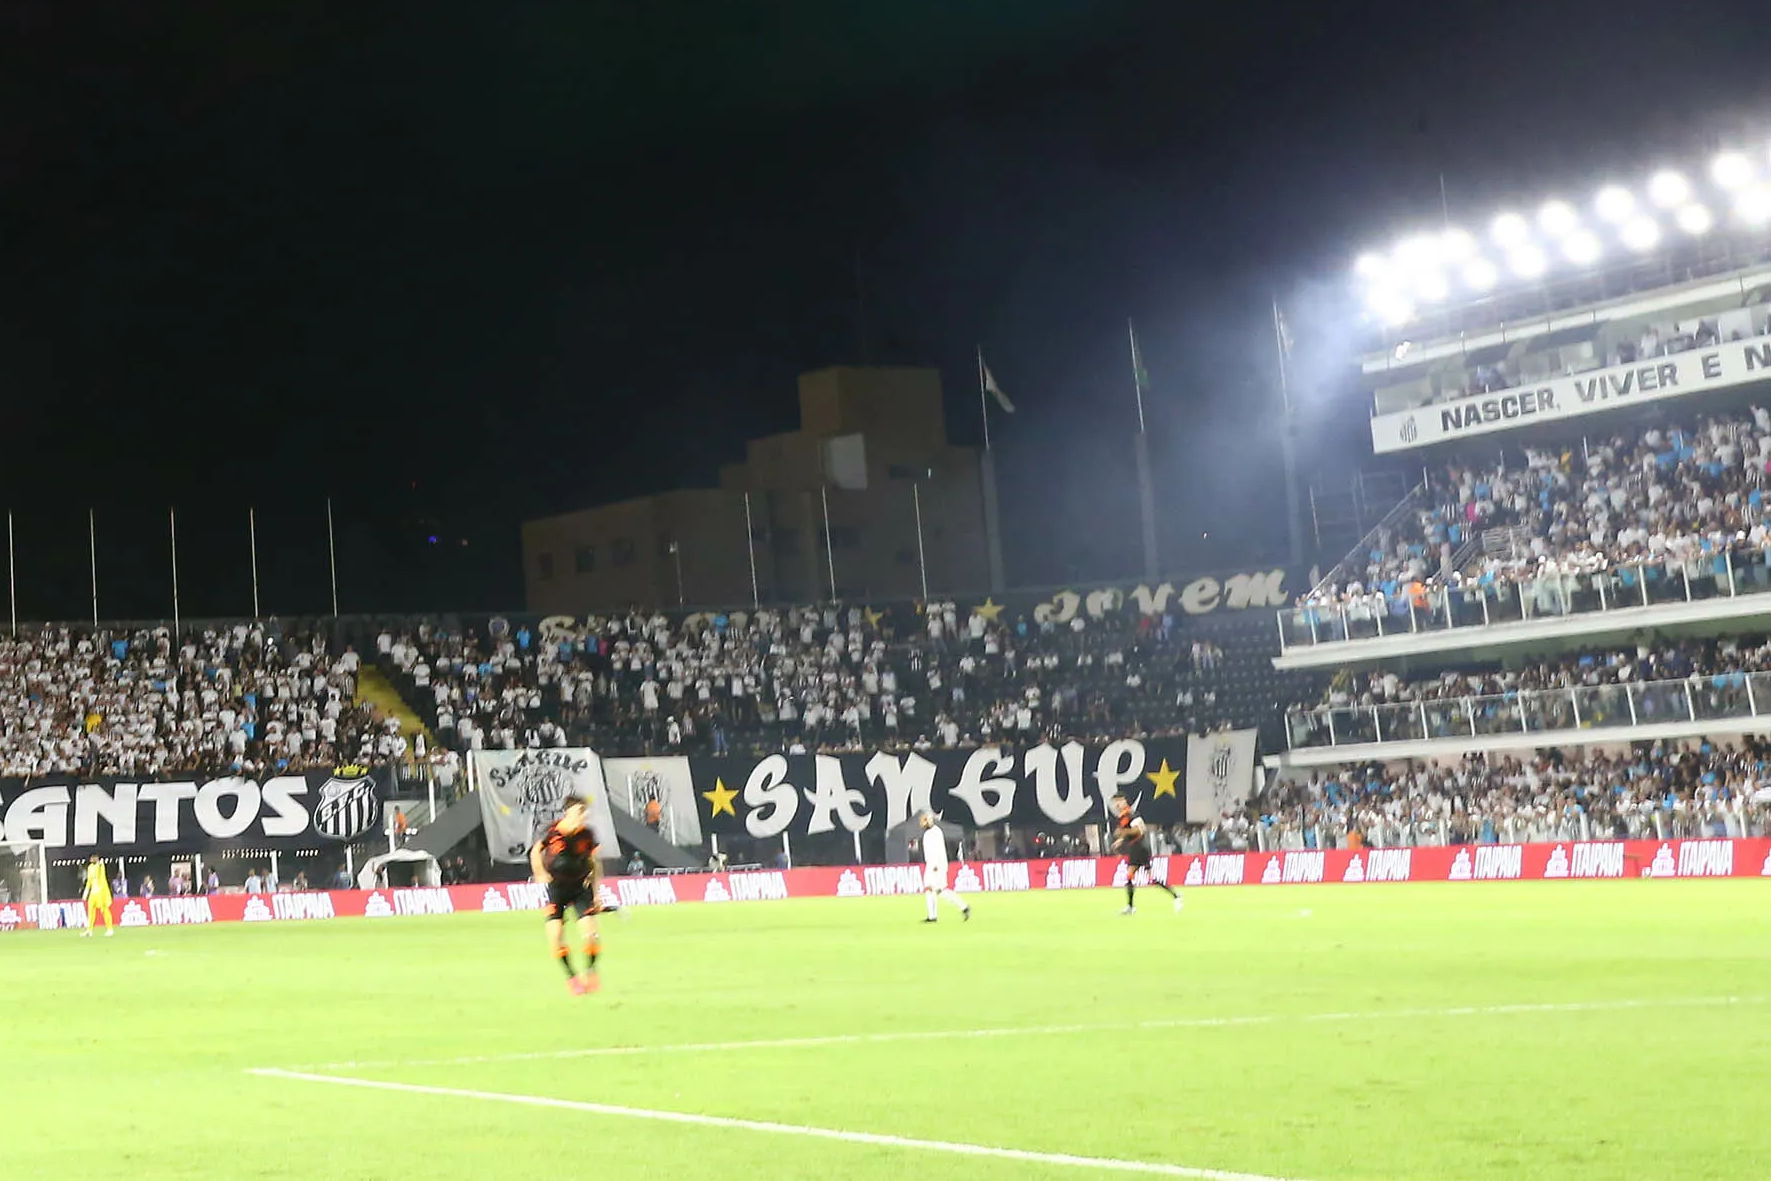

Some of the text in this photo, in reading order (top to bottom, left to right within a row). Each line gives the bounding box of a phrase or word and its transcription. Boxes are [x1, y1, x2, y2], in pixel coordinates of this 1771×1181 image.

[1441, 387, 1562, 432] NASCER,
[1574, 362, 1679, 403] VIVER
[1701, 352, 1722, 379] E
[1474, 845, 1523, 879] ITAIPAVA
[1571, 842, 1624, 878] ITAIPAVA
[1677, 840, 1734, 877] ITAIPAVA
[864, 865, 926, 895] ITAIPAVA
[149, 896, 213, 924] ITAIPAVA
[272, 890, 335, 919] ITAIPAVA
